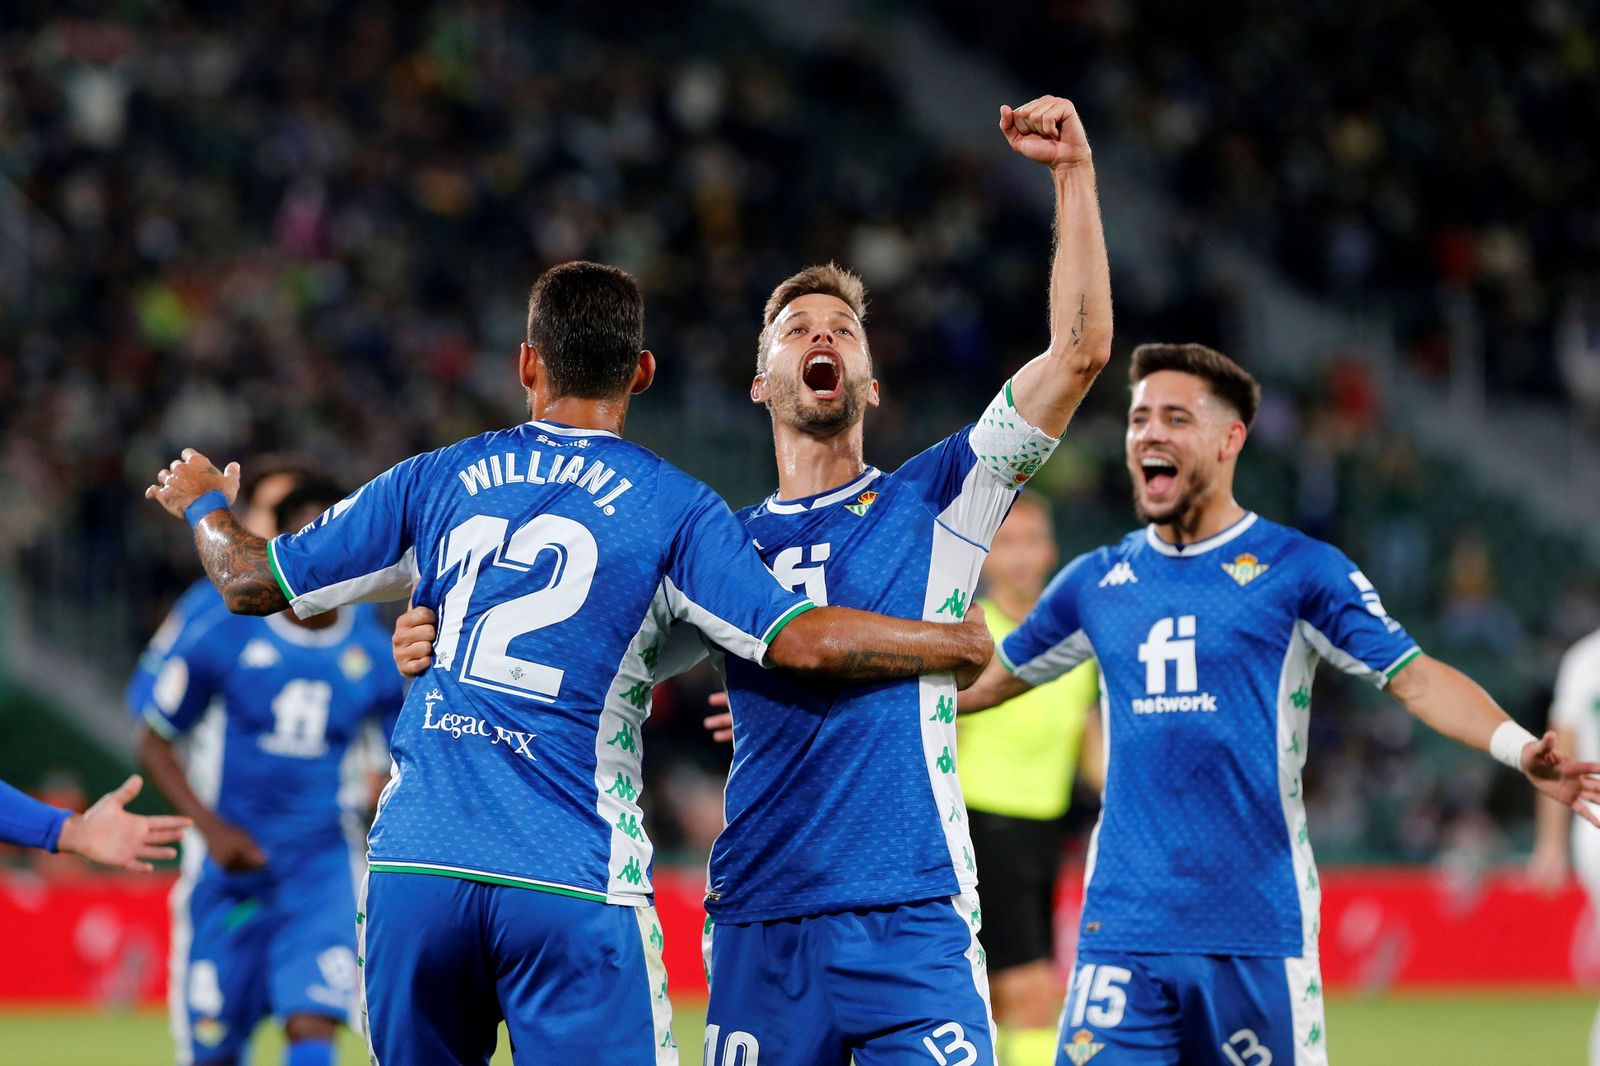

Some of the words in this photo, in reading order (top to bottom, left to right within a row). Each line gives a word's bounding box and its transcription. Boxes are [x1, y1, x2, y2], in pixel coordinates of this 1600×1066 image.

[458, 451, 616, 496] WILLIAN
[434, 513, 599, 704] 12
[1138, 615, 1197, 695] fi
[1132, 692, 1217, 715] network
[1071, 963, 1132, 1029] 15
